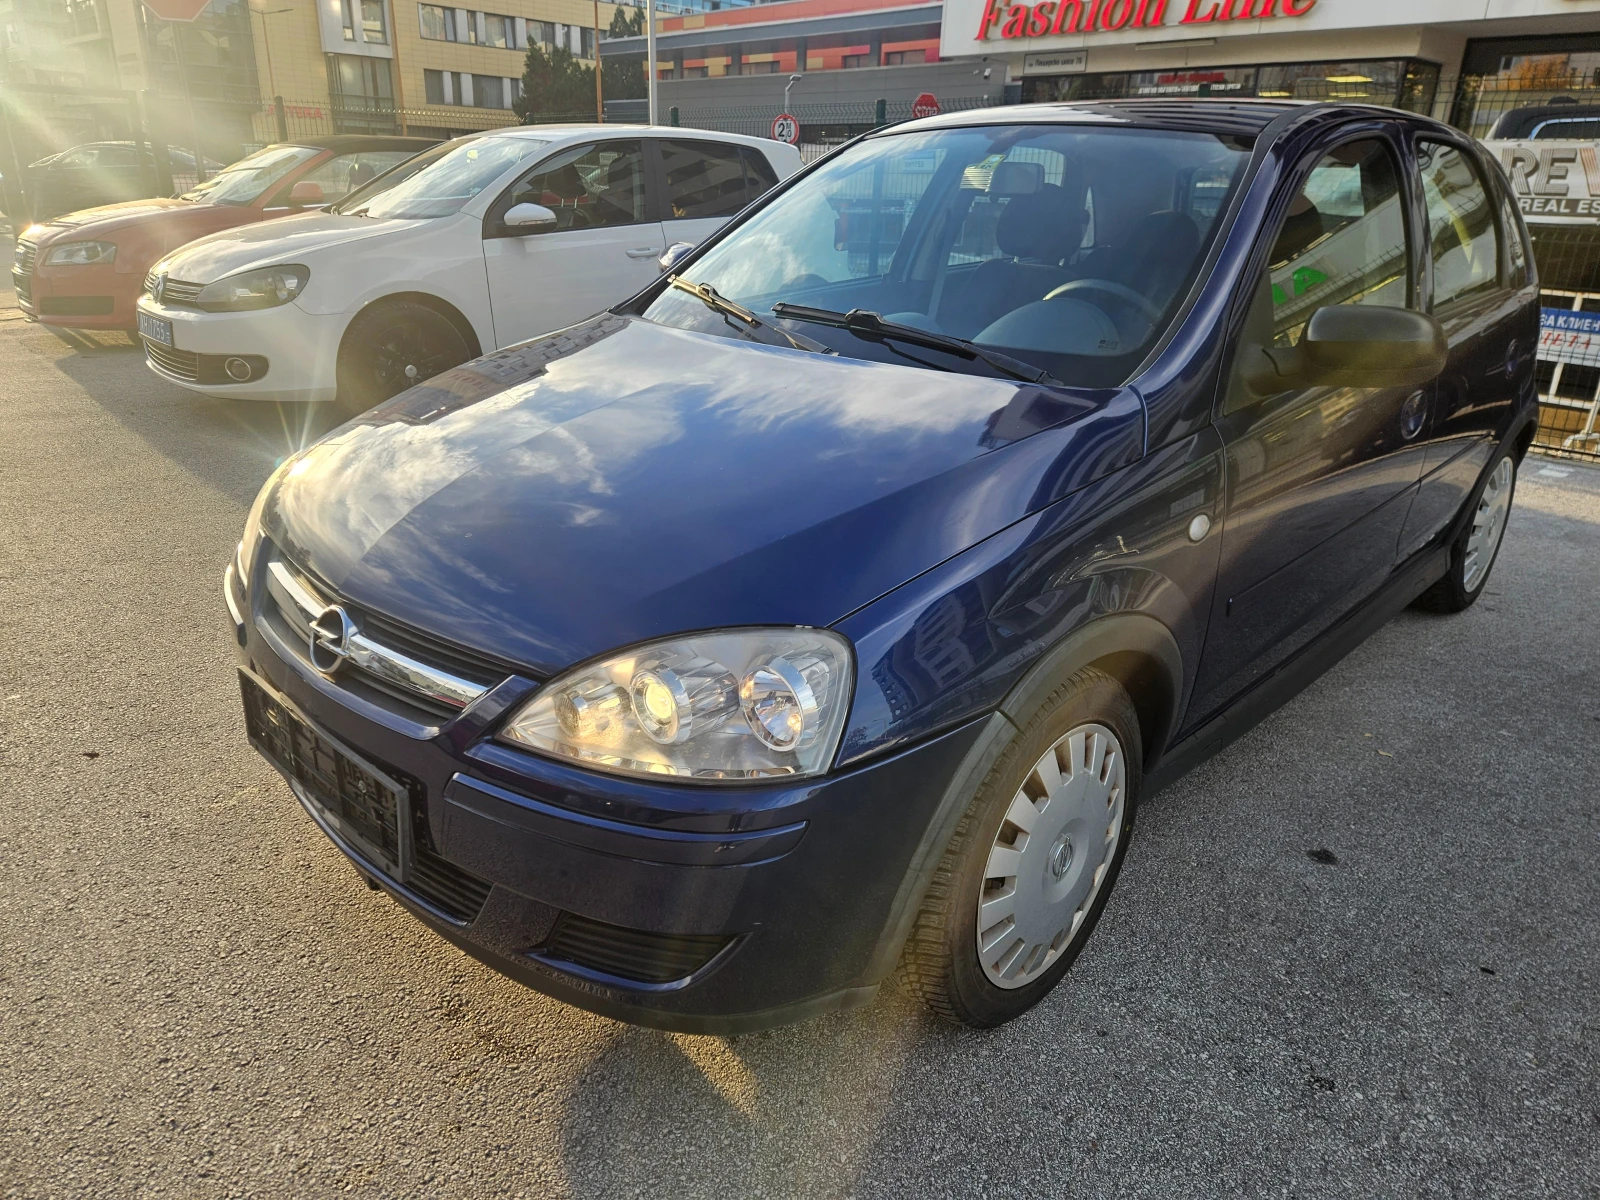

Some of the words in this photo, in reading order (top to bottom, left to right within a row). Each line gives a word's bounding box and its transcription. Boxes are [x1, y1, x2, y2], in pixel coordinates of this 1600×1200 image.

[973, 0, 1173, 41] Fashion
[267, 104, 325, 120] АТЕКА
[915, 105, 938, 118] STOP
[1520, 198, 1571, 214] REAL
